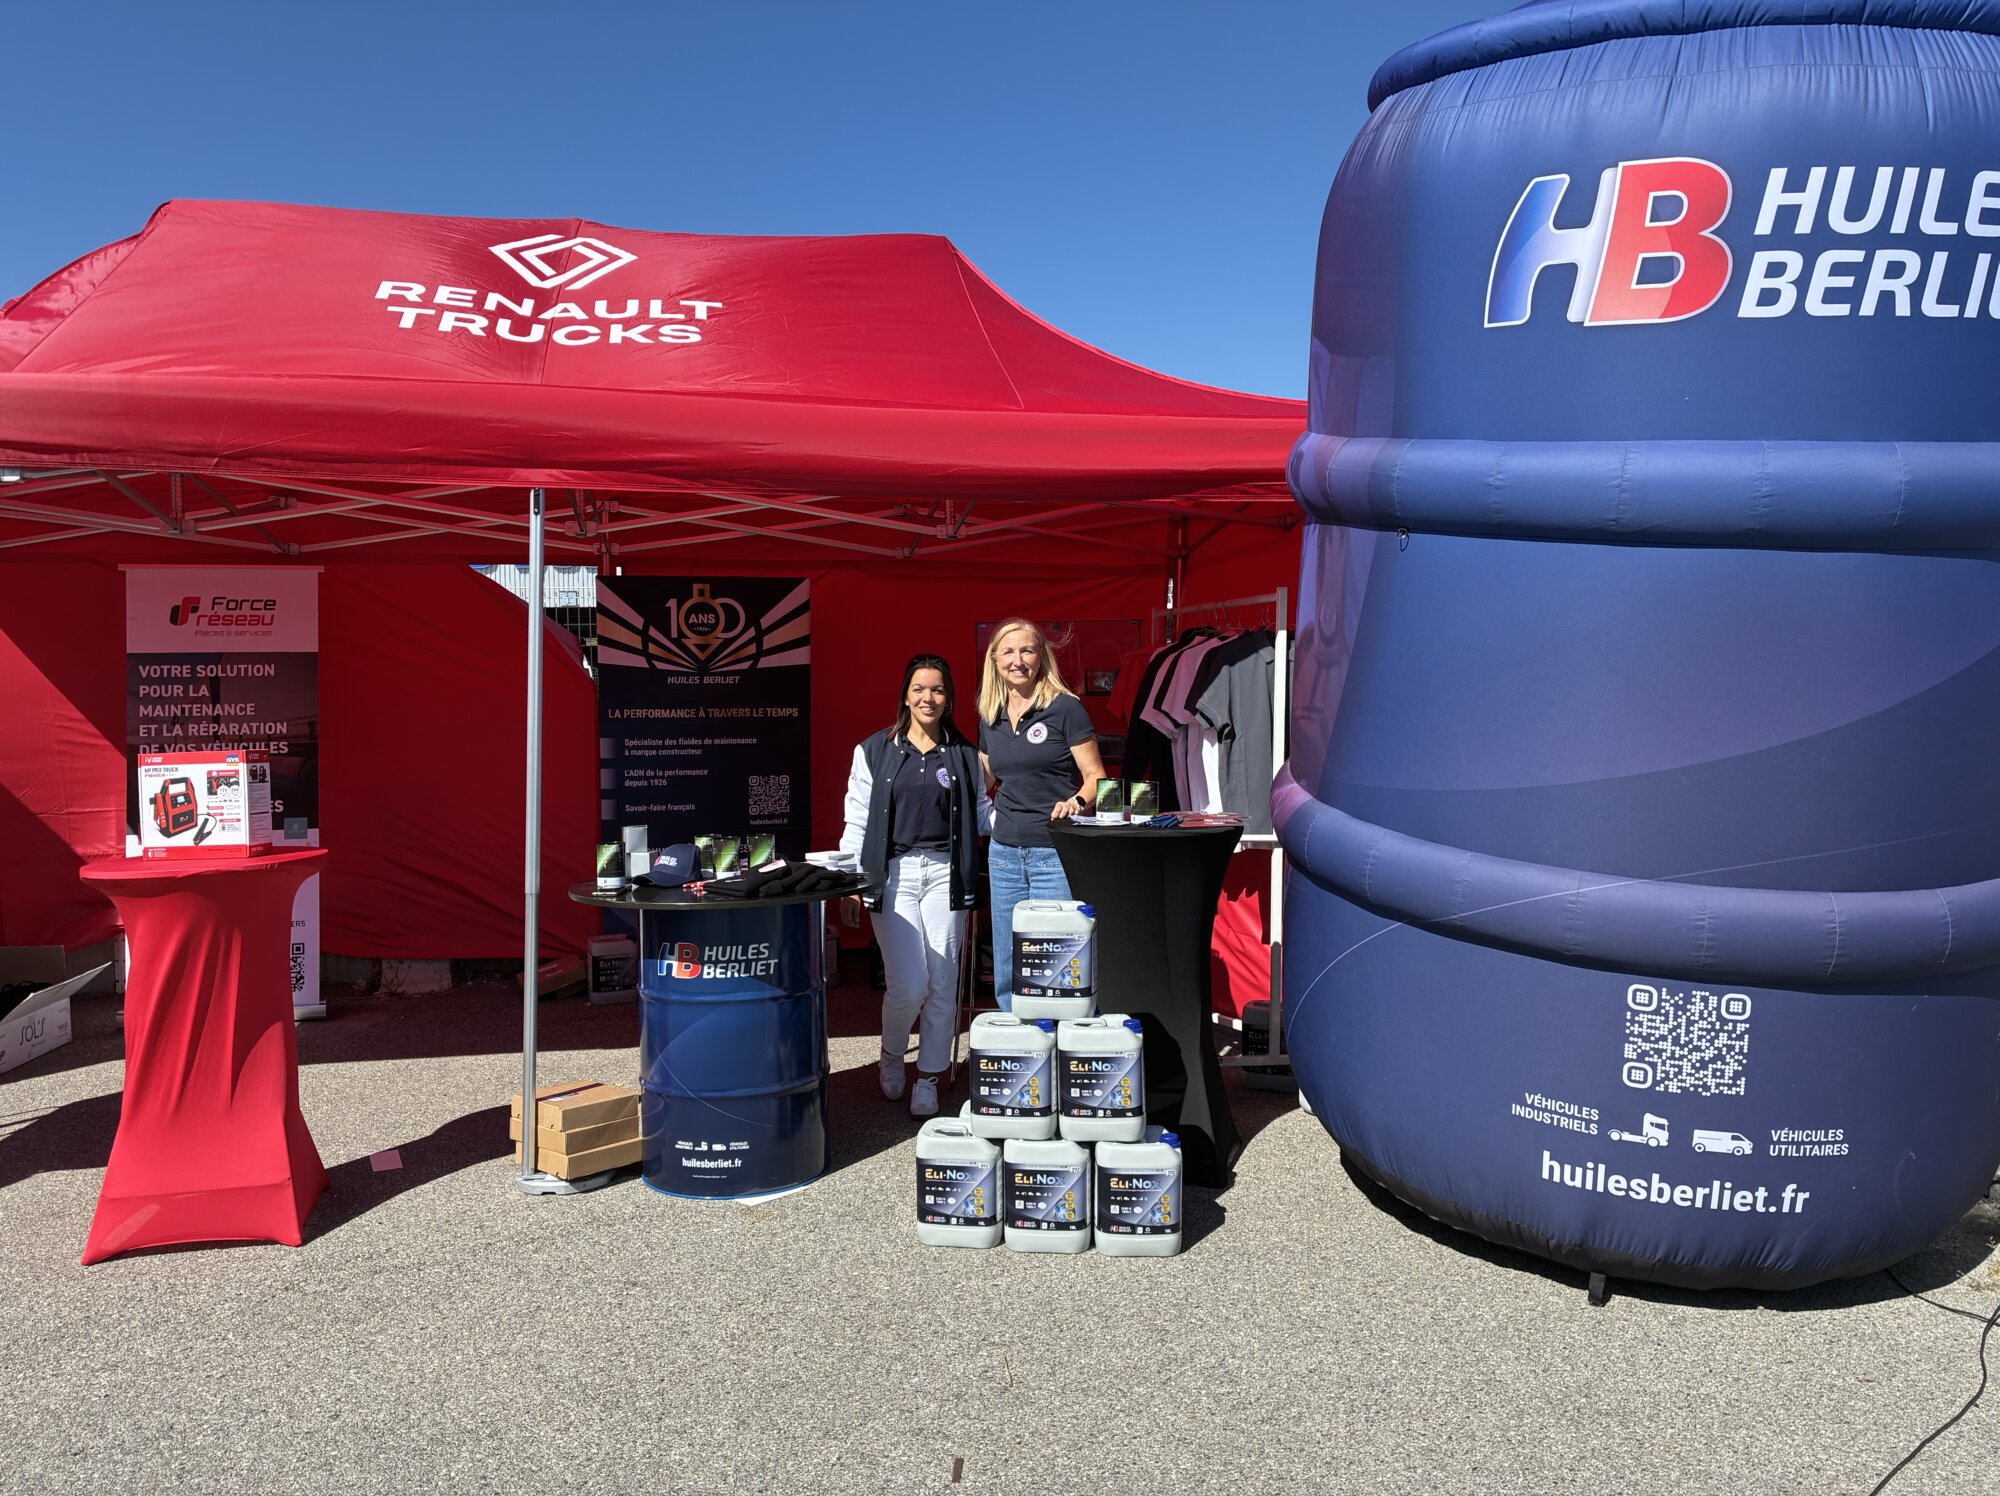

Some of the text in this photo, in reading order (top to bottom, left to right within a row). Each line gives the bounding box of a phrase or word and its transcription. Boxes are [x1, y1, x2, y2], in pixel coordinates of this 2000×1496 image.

[1484, 156, 1734, 328] HB
[1737, 249, 2000, 320] BERLI
[374, 280, 723, 321] RENAULT
[386, 305, 702, 346] TRUCKS
[211, 596, 276, 611] Force
[196, 611, 274, 626] réseau
[689, 614, 716, 624] ANS
[139, 664, 275, 678] VOTRE SOLUTION
[667, 676, 740, 684] HUILES BERLIET
[139, 684, 209, 698] POUR LA
[139, 703, 255, 717] MAINTENANCE
[608, 706, 799, 718] LA PERFORMANCE À TRAVERS LE TEMPS
[139, 721, 287, 737] ET LA RÉPARATION
[140, 744, 160, 754] DE
[164, 743, 195, 753] VOS
[624, 738, 663, 747] Spécialiste
[664, 738, 677, 746] des
[713, 737, 757, 745] maintenance
[631, 749, 657, 757] marque
[664, 768, 708, 777] performance
[624, 779, 648, 788] depuis
[625, 804, 695, 812] Savoir-faire français
[704, 943, 769, 961] HUILES
[658, 942, 701, 979] HB
[703, 959, 778, 978] BERLIET
[20, 1017, 45, 1046] SOL'S
[1525, 1093, 1599, 1121] VÉHICULES
[1511, 1103, 1598, 1135] INDUSTRIELS
[1770, 1127, 1845, 1142] VÉHICULES
[1769, 1143, 1849, 1157] UTILITAIRES
[682, 1157, 742, 1169] huilesberliet.fr
[1541, 1150, 1810, 1214] huilesberliet.fr
